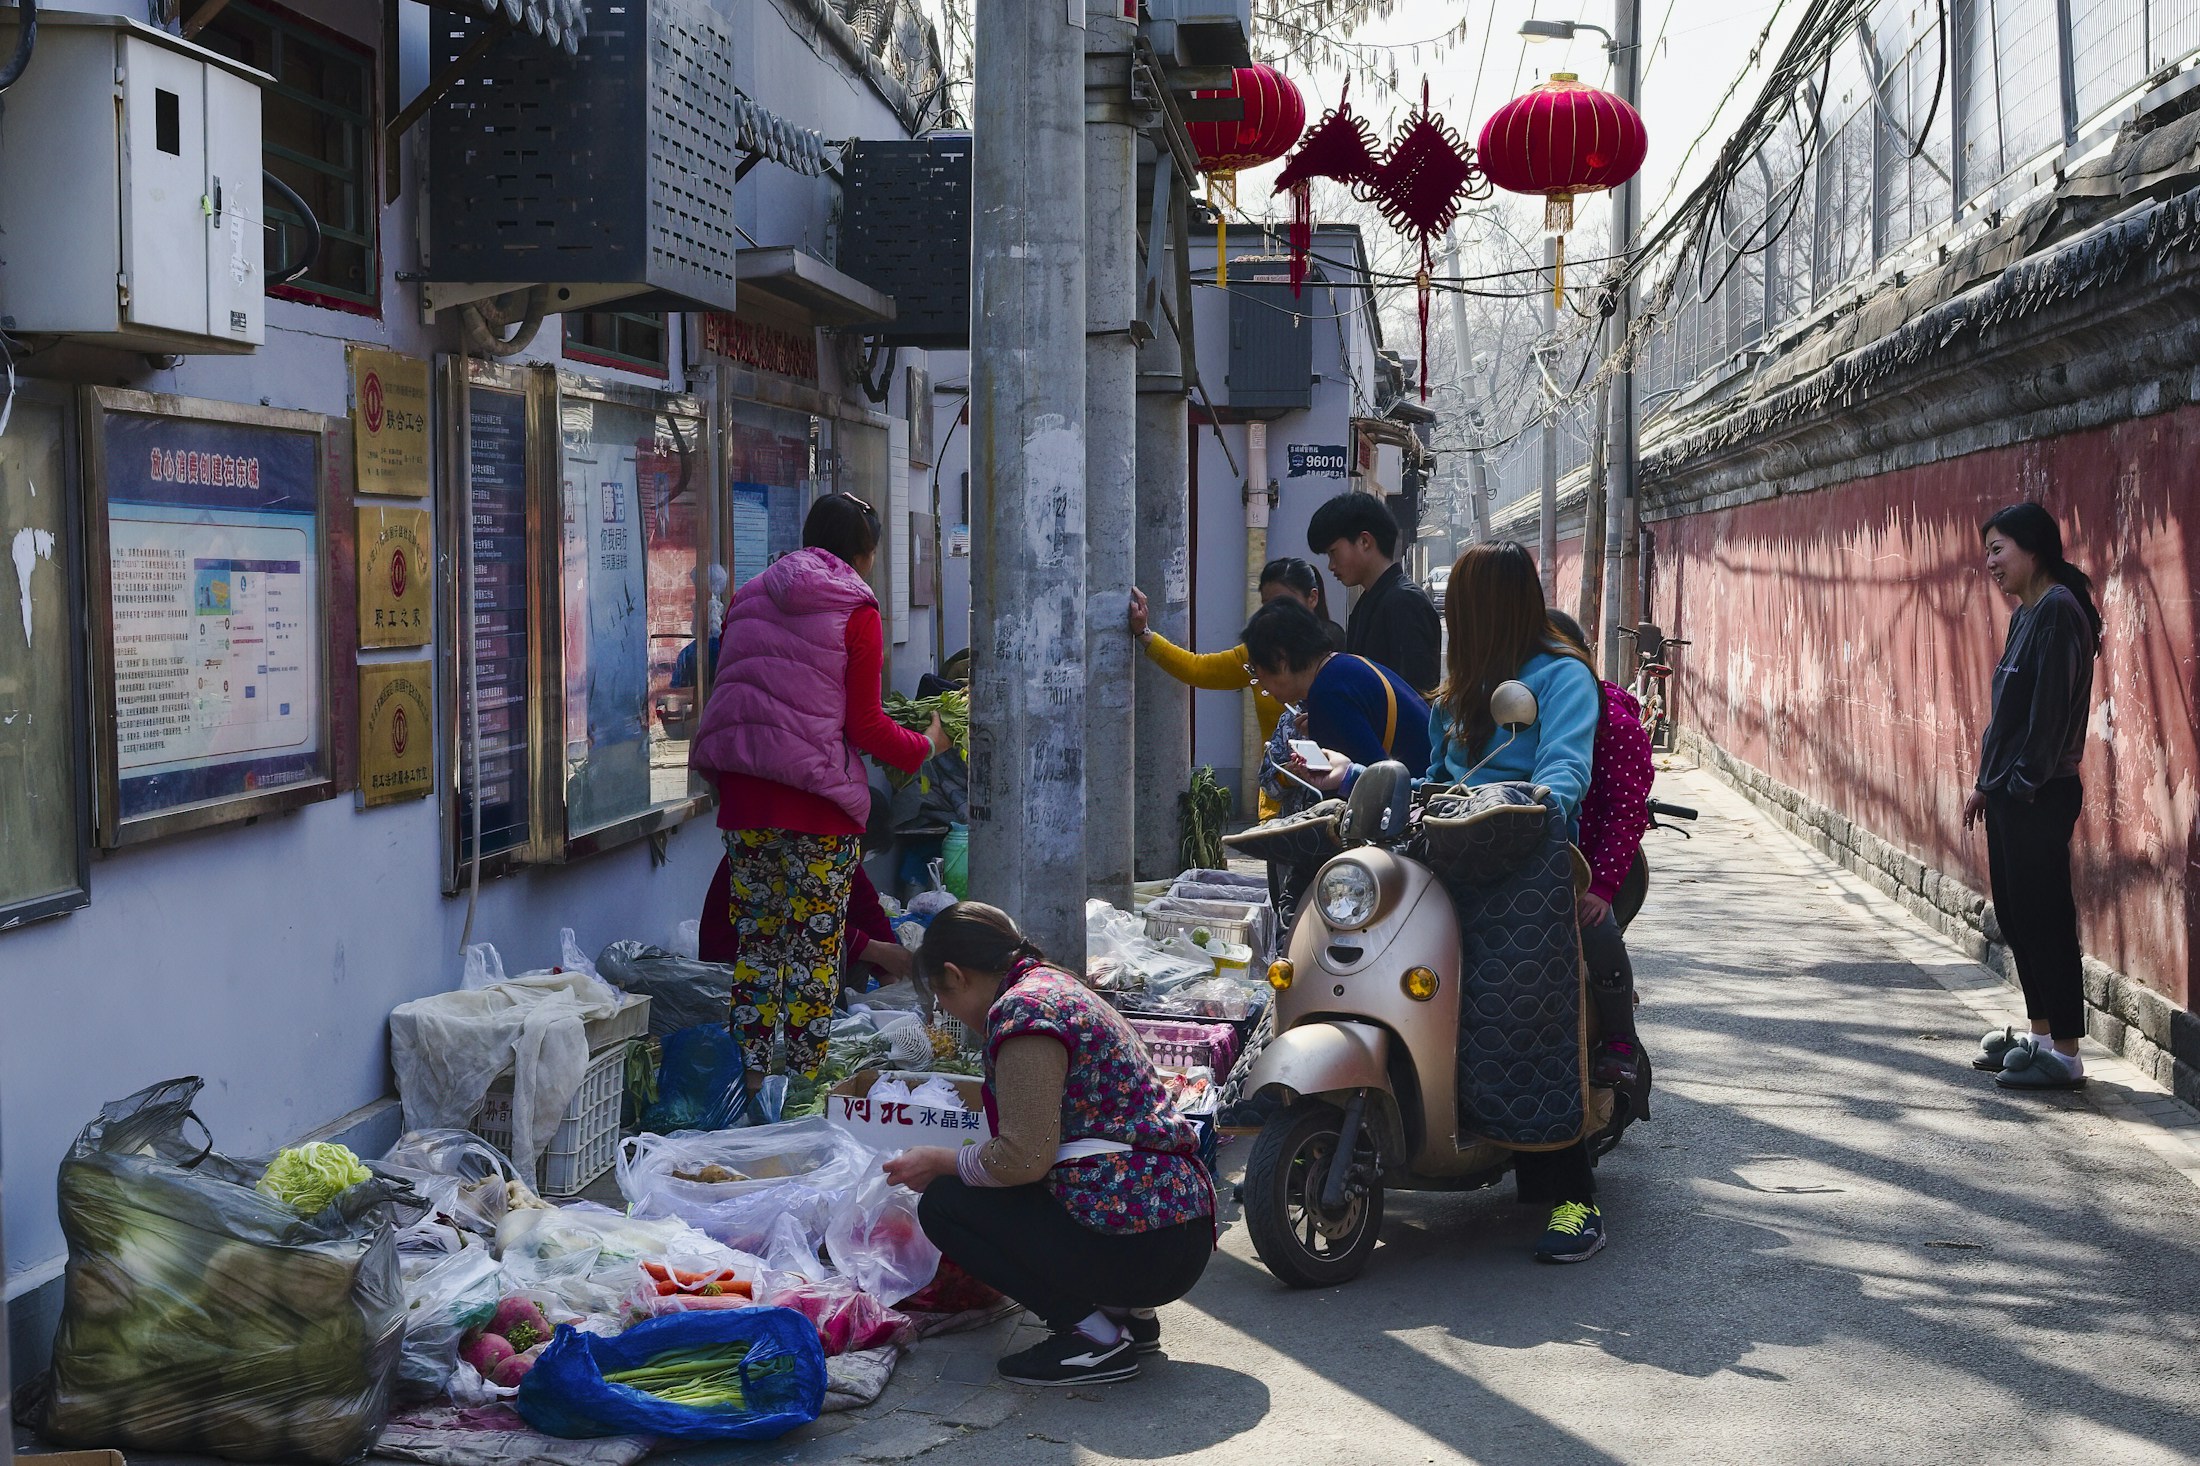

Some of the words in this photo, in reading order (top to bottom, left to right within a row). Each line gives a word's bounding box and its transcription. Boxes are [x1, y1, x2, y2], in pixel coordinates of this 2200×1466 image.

[385, 409, 424, 433] 联合工会
[150, 446, 260, 490] 放心消费创建在东城
[1306, 455, 1344, 468] 96010
[374, 608, 421, 629] 职工之家
[843, 1097, 914, 1126] 河北
[920, 1108, 980, 1130] 水晶梨
